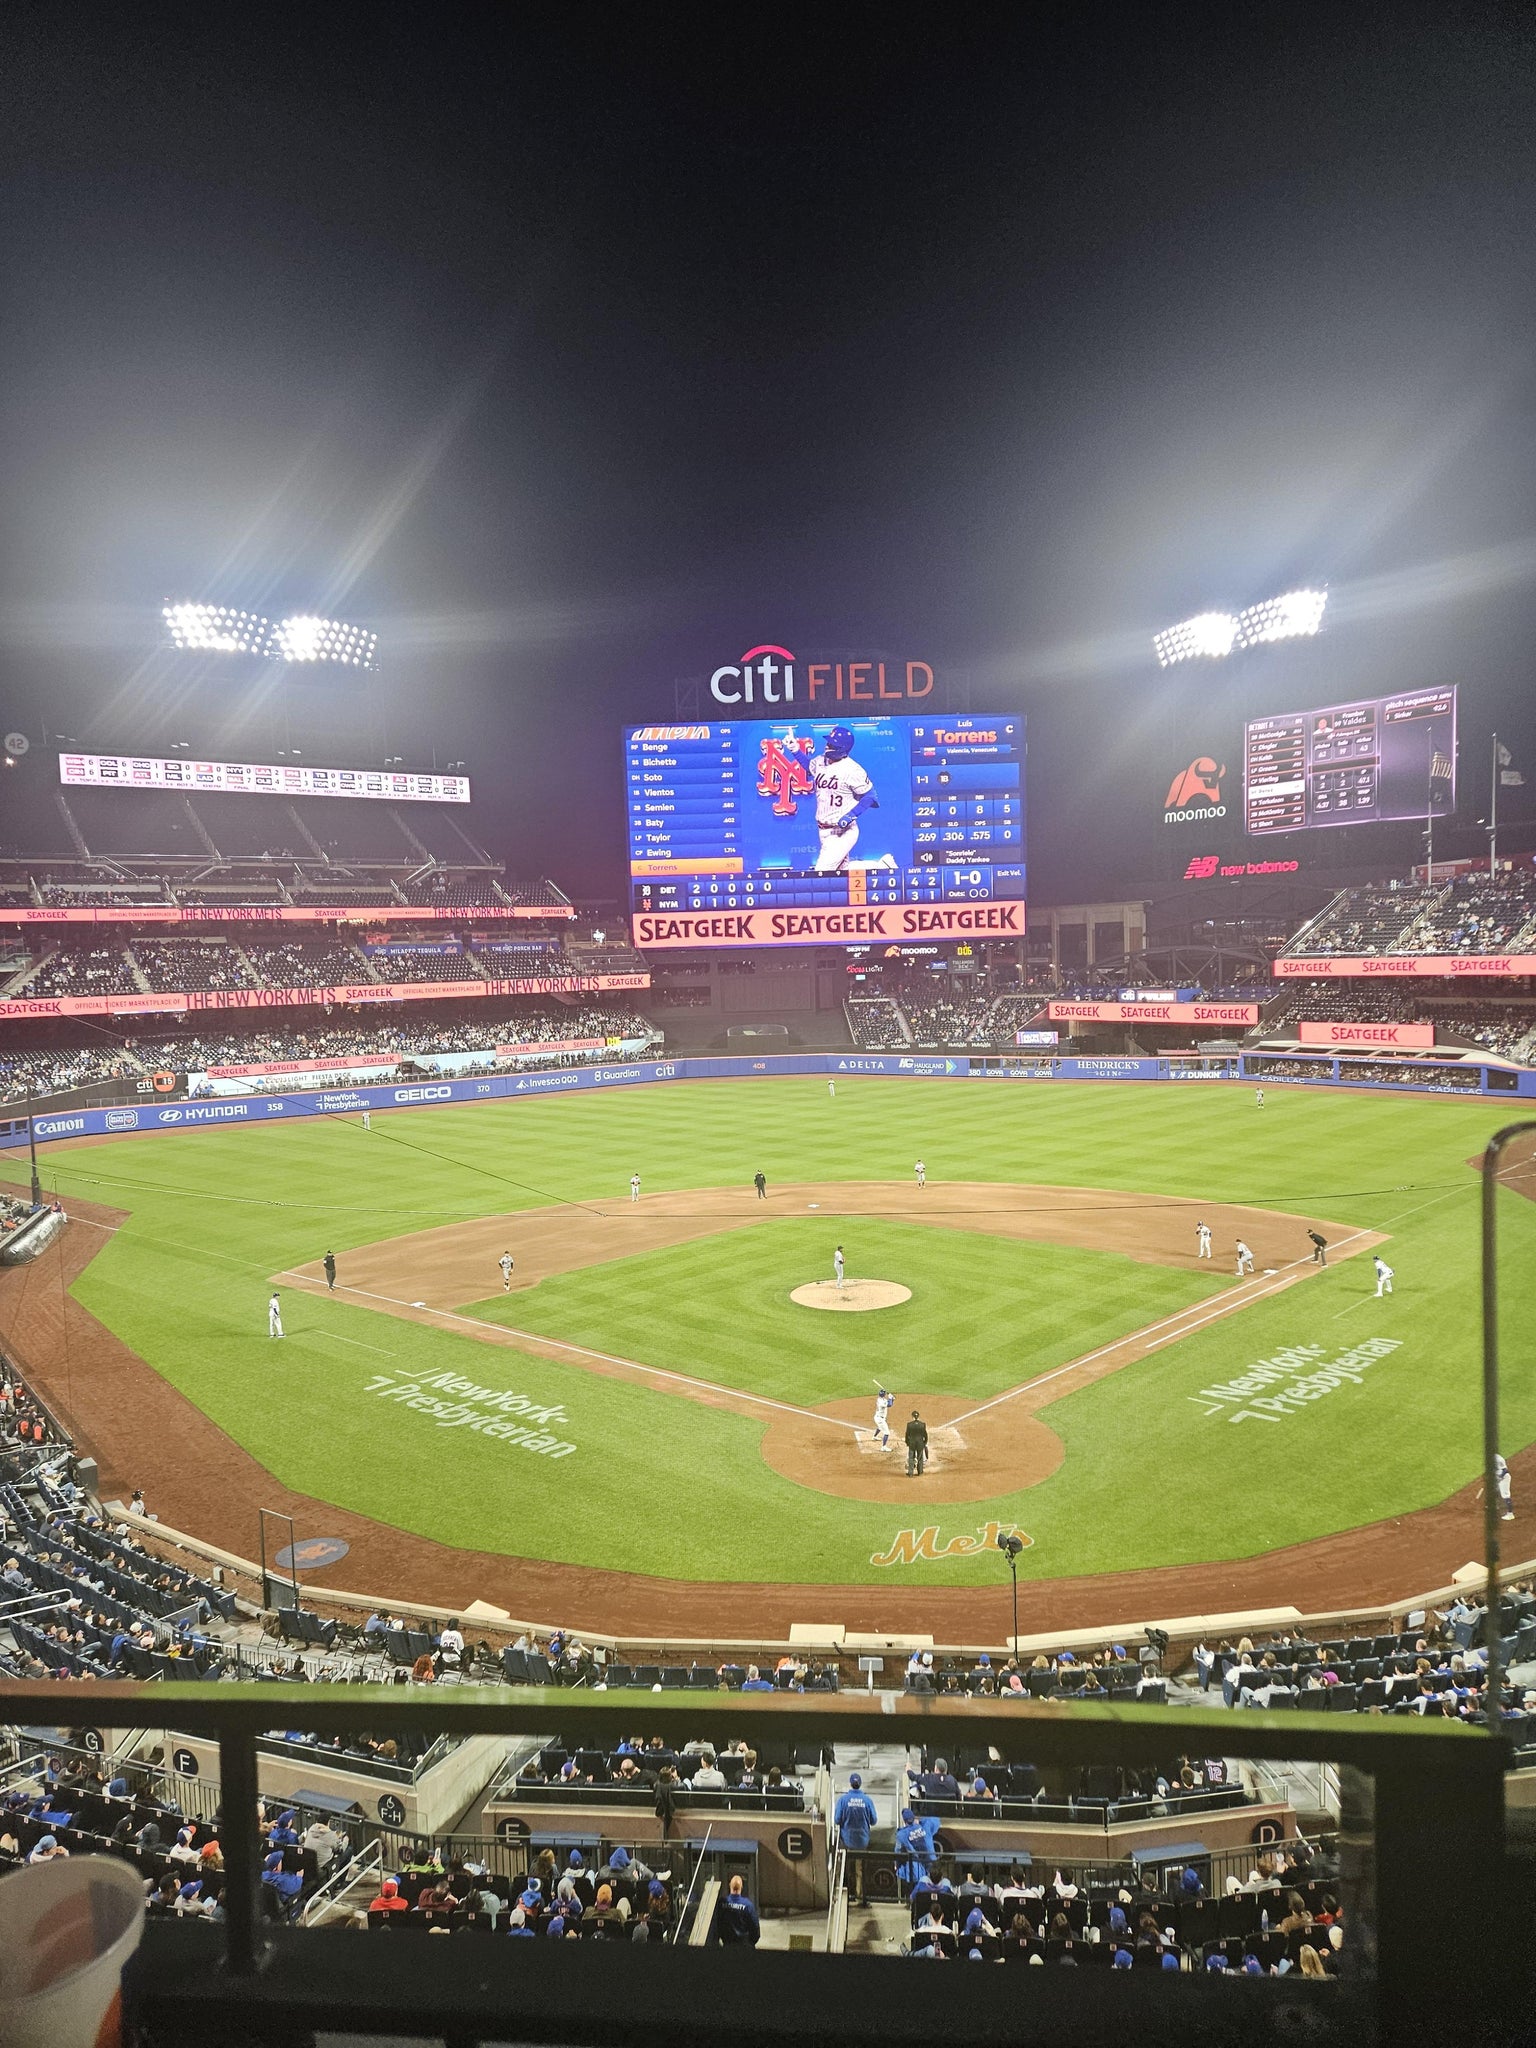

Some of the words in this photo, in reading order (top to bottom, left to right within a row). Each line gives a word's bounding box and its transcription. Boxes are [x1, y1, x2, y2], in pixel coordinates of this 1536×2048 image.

[710, 655, 794, 703] citi
[808, 661, 934, 701] FIELD
[1386, 700, 1403, 710] pitch
[1404, 695, 1438, 706] sequence
[1343, 717, 1366, 726] Valdez
[914, 728, 924, 737] 13
[1005, 725, 1014, 733] C
[934, 730, 997, 744] Torrens
[9, 738, 25, 749] 42
[643, 744, 668, 752] Benge
[643, 758, 677, 766] Bichette
[830, 795, 843, 806] 13
[645, 804, 675, 812] Semien
[915, 807, 936, 816] .224
[949, 806, 957, 815] 0
[976, 805, 983, 814] 8
[1004, 805, 1011, 813] 5
[1164, 806, 1226, 823] moomoo
[645, 819, 664, 828] Baty
[646, 834, 671, 843] Taylor
[916, 833, 936, 842] .269
[943, 832, 964, 841] .306
[970, 831, 991, 840] .575
[1004, 830, 1011, 839] 0
[647, 849, 672, 858] Ewing
[1221, 865, 1245, 876] new
[1247, 860, 1299, 874] balance
[693, 884, 700, 894] 2
[710, 884, 718, 893] 0
[728, 883, 736, 892] 0
[746, 882, 754, 892] 0
[763, 882, 771, 891] 0
[872, 878, 878, 887] 7
[888, 878, 896, 887] 0
[911, 877, 919, 886] 4
[928, 877, 936, 886] 2
[693, 899, 700, 908] 0
[728, 897, 736, 907] 0
[746, 897, 754, 906] 0
[871, 893, 879, 902] 4
[888, 892, 896, 901] 0
[911, 891, 919, 900] 3
[929, 891, 935, 900] 1
[27, 911, 68, 919] SEATGEEK
[180, 909, 198, 920] THE
[200, 909, 222, 920] NEW
[226, 909, 252, 920] YORK
[256, 908, 282, 919] METS
[434, 908, 449, 918] THE
[450, 908, 468, 918] NEW
[470, 907, 492, 917] YORK
[493, 907, 515, 917] METS
[640, 914, 755, 942] SEATGEEK
[772, 910, 887, 937] SEATGEEK
[903, 905, 1018, 933] SEATGEEK
[901, 947, 938, 955] moomoo
[1283, 962, 1332, 973] SEATGEEK
[1362, 961, 1417, 973] SEATGEEK
[1450, 959, 1511, 972] SEATGEEK
[0, 1001, 61, 1014] SEATGEEK
[128, 1000, 172, 1008] MARKETPLACE
[184, 993, 213, 1009] THE
[217, 991, 249, 1008] NEW
[253, 989, 294, 1006] YORK
[298, 988, 336, 1005] METS
[346, 988, 393, 999] SEATGEEK
[483, 980, 506, 996] THE
[508, 979, 533, 994] NEW
[537, 978, 567, 993] YORK
[570, 977, 599, 991] METS
[607, 978, 644, 987] SEATGEEK
[1055, 1006, 1100, 1018] SEATGEEK
[1120, 1006, 1171, 1019] SEATGEEK
[1194, 1007, 1249, 1020] SEATGEEK
[1331, 1026, 1399, 1042] SEATGEEK
[573, 1040, 599, 1048] SEATGEEK
[265, 1063, 299, 1072] SEATGEEK
[315, 1059, 348, 1068] SEATGEEK
[363, 1056, 395, 1065] SEATGEEK
[849, 1061, 884, 1069] DELTA
[1077, 1061, 1140, 1070] HENDRICK'S
[603, 1070, 640, 1080] Guardian
[655, 1065, 675, 1077] citi
[1229, 1071, 1240, 1079] 370
[137, 1080, 153, 1089] citi
[162, 1077, 173, 1085] 15
[529, 1078, 560, 1087] Invesco
[561, 1075, 578, 1084] QQQ
[1261, 1076, 1305, 1084] CADILLAC
[395, 1086, 451, 1102] GEICO
[477, 1085, 490, 1093] 370
[1428, 1086, 1483, 1095] CADILLAC
[324, 1094, 360, 1102] NewYork-
[267, 1103, 283, 1111] 358
[324, 1100, 369, 1110] Presbyterian
[186, 1105, 247, 1119] HYUNDAI
[34, 1118, 84, 1135] Canon
[1199, 1343, 1327, 1402] NewYork-
[1249, 1337, 1404, 1414] Presbyterian
[419, 1371, 569, 1424] NewYork-
[377, 1383, 577, 1459] Presbyterian
[85, 1731, 98, 1750] G
[179, 1754, 191, 1772] F
[1208, 1766, 1223, 1782] 12
[380, 1807, 401, 1823] F-H
[505, 1823, 520, 1844] E
[1260, 1825, 1276, 1844] D
[787, 1834, 801, 1855] E
